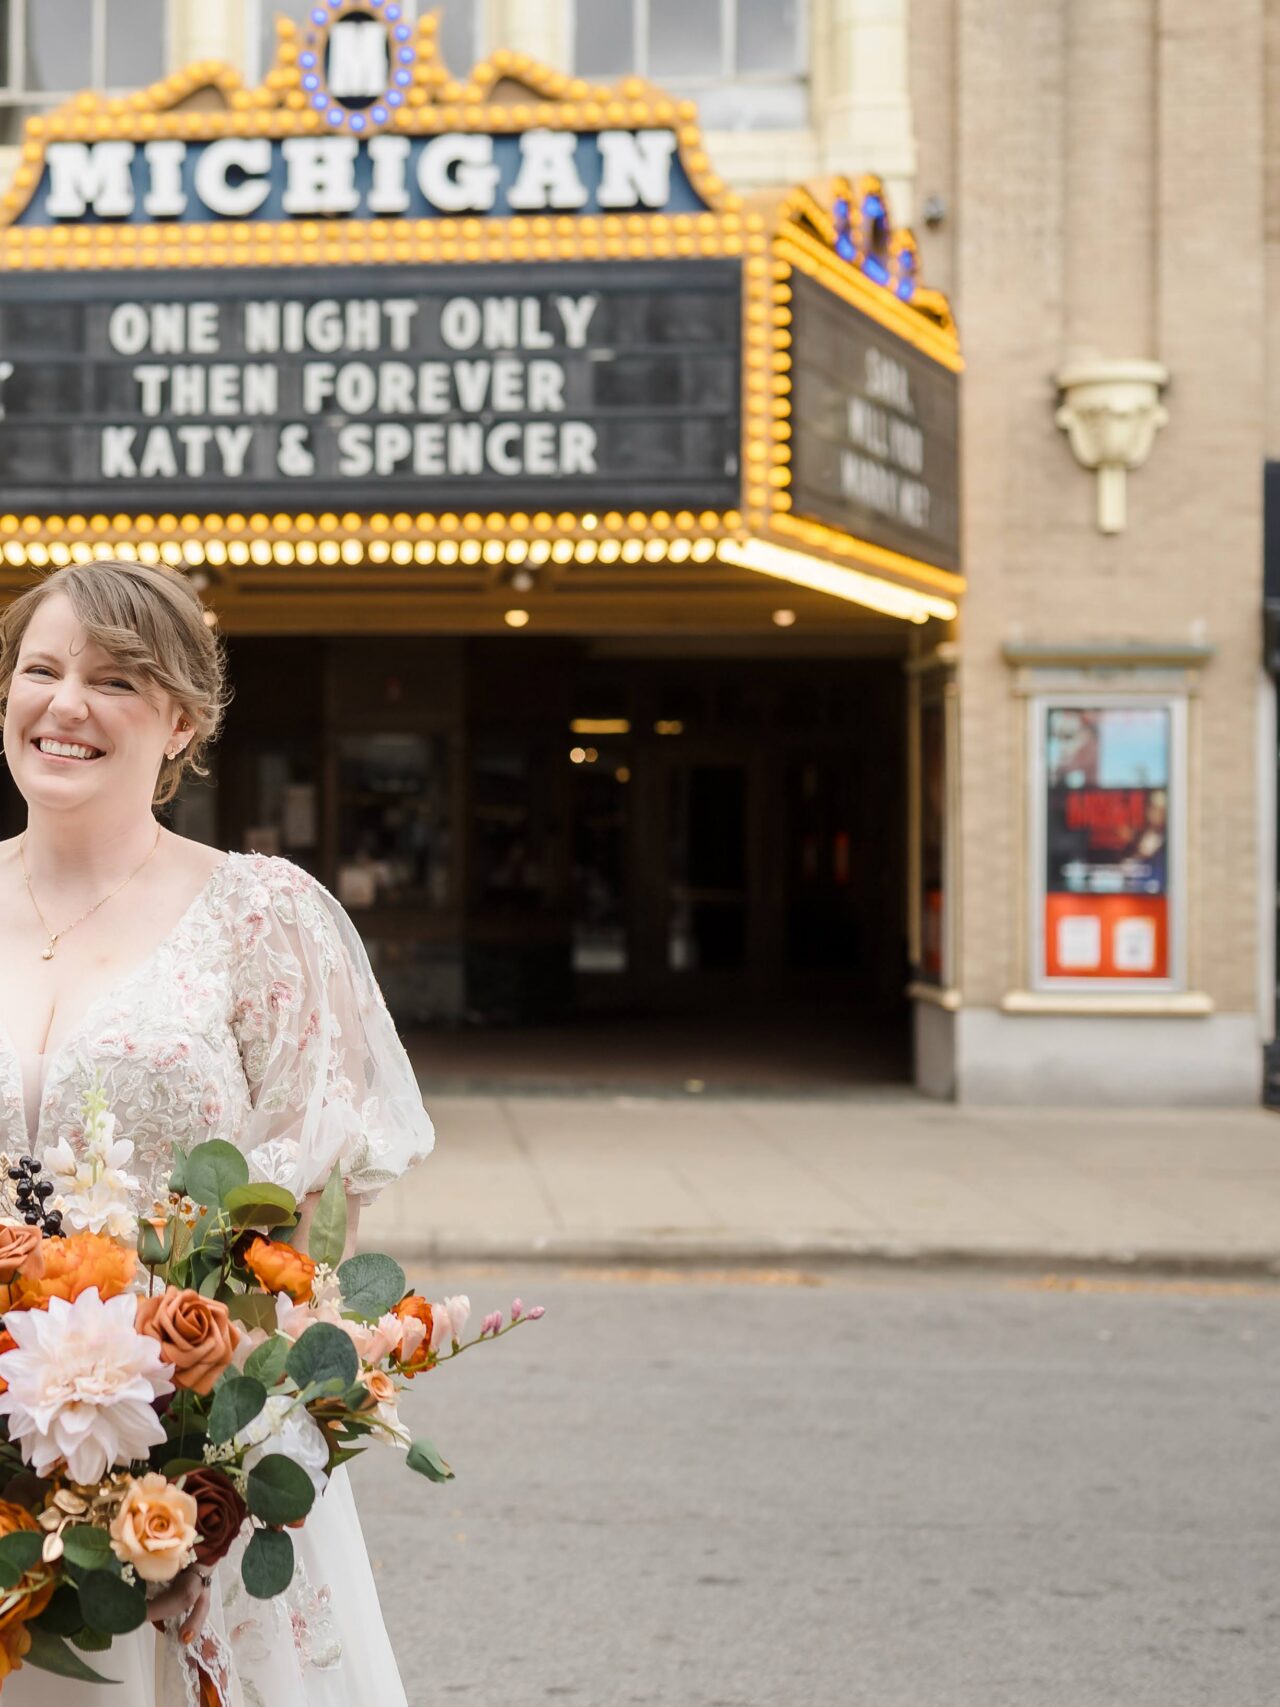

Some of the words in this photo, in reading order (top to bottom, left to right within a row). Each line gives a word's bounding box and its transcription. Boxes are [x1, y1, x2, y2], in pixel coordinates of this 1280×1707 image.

[46, 130, 677, 217] MICHIGAN
[109, 302, 220, 355] ONE
[244, 299, 418, 353] NIGHT
[441, 295, 597, 350] ONLY
[133, 364, 278, 416] THEN
[303, 359, 566, 415] FOREVER
[101, 424, 253, 478] KATY
[277, 424, 314, 477] &
[338, 421, 598, 476] SPENCER
